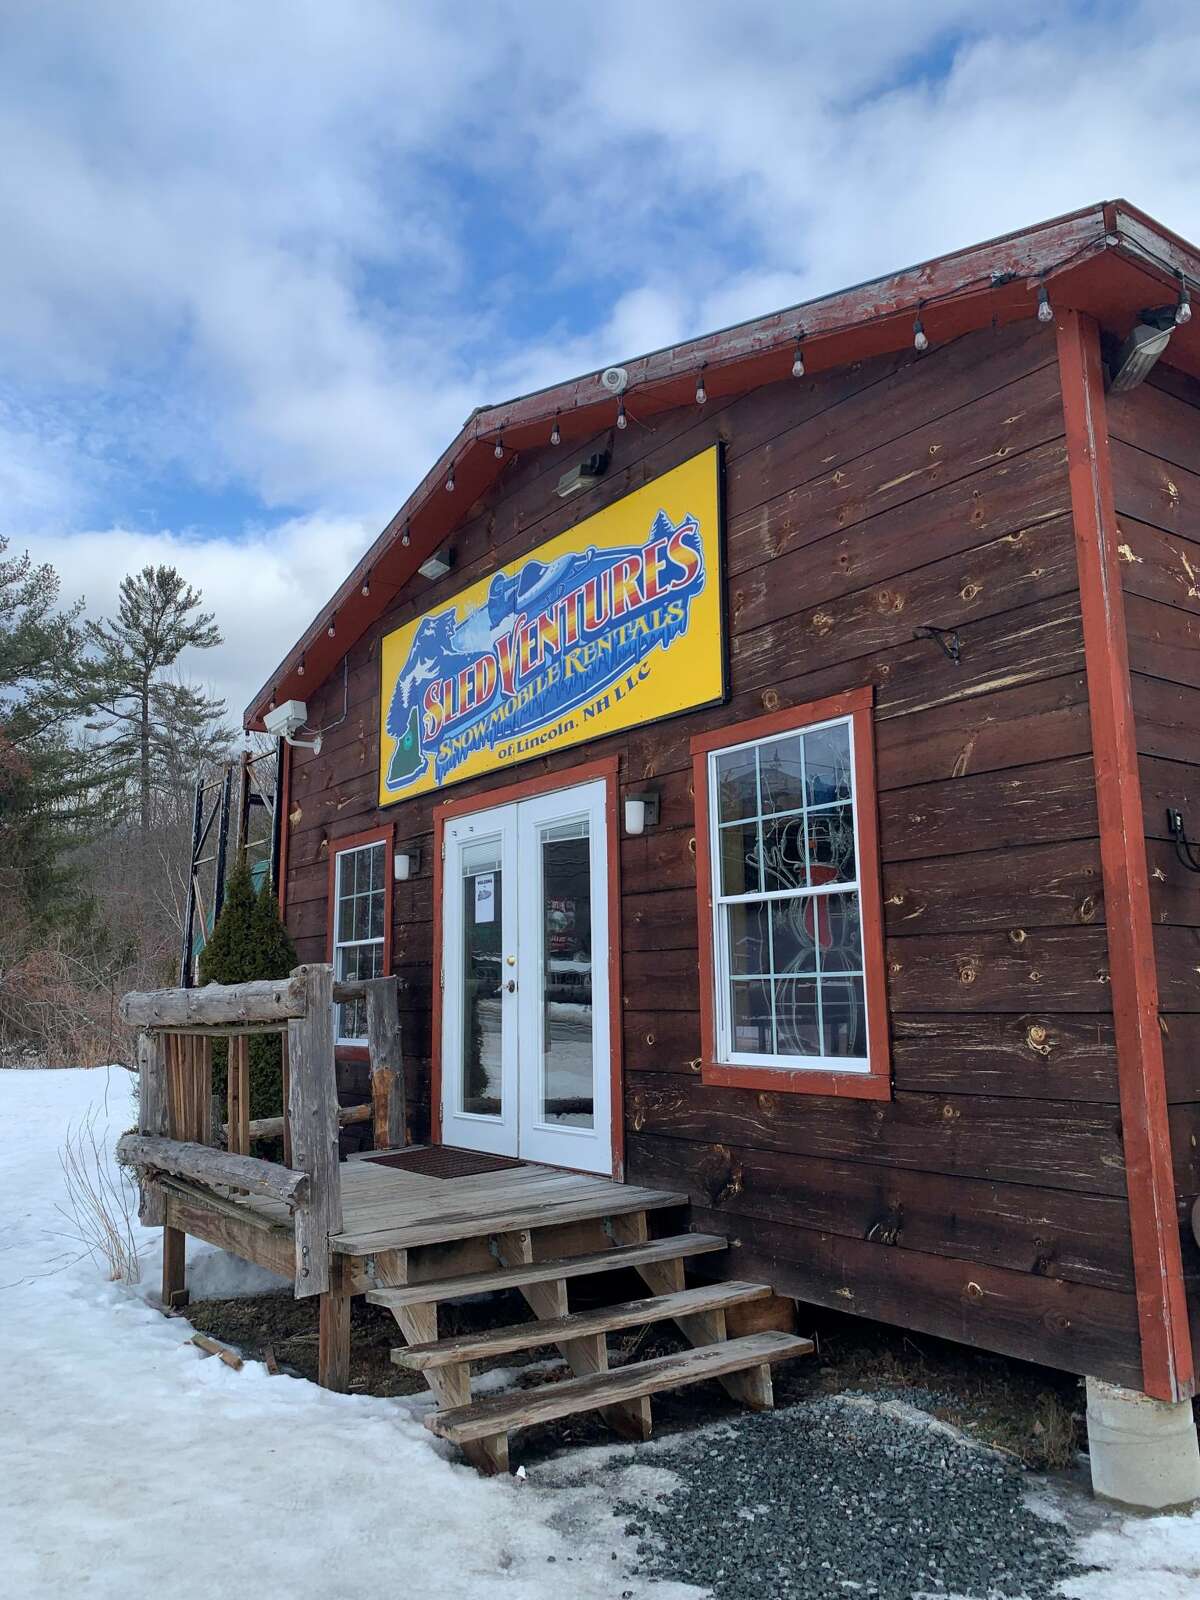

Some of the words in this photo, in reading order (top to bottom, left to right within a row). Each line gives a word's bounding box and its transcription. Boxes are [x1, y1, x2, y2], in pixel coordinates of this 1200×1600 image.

[437, 661, 561, 763] SNOWMOBILE
[564, 599, 685, 681] RENTALS
[497, 741, 514, 759] of
[582, 695, 611, 721] NH
[613, 661, 651, 701] LLC
